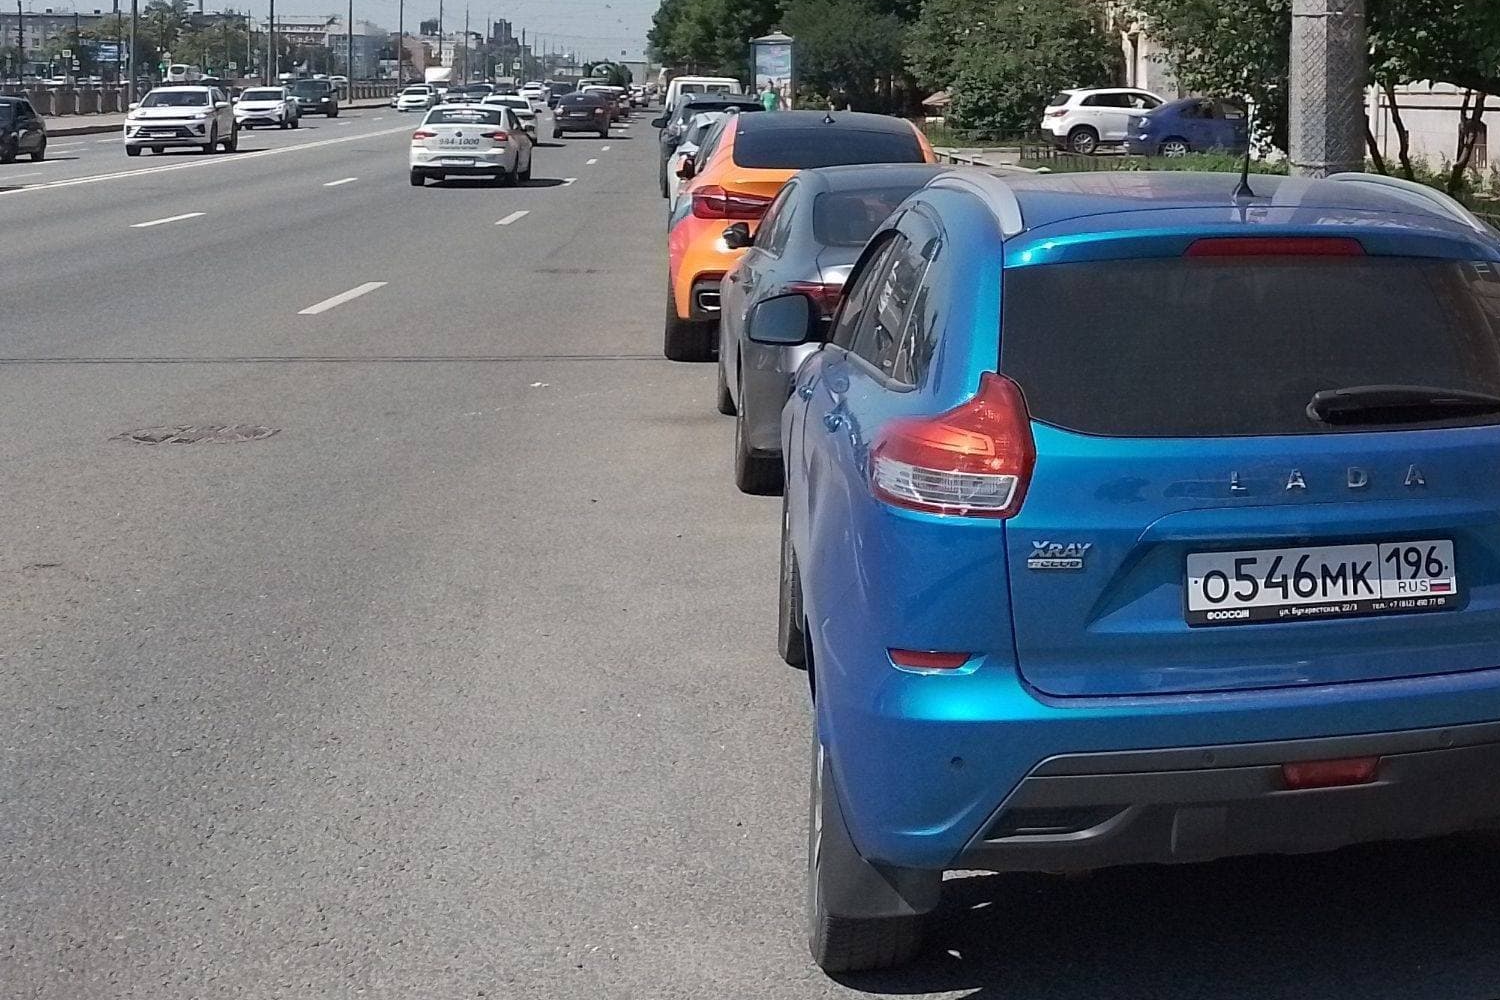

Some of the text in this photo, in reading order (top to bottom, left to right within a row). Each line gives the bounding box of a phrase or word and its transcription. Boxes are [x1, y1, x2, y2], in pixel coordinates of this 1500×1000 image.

[1230, 463, 1425, 491] LADA
[1028, 540, 1094, 558] XRAY
[1385, 545, 1444, 581] 196
[1398, 580, 1429, 593] RUS
